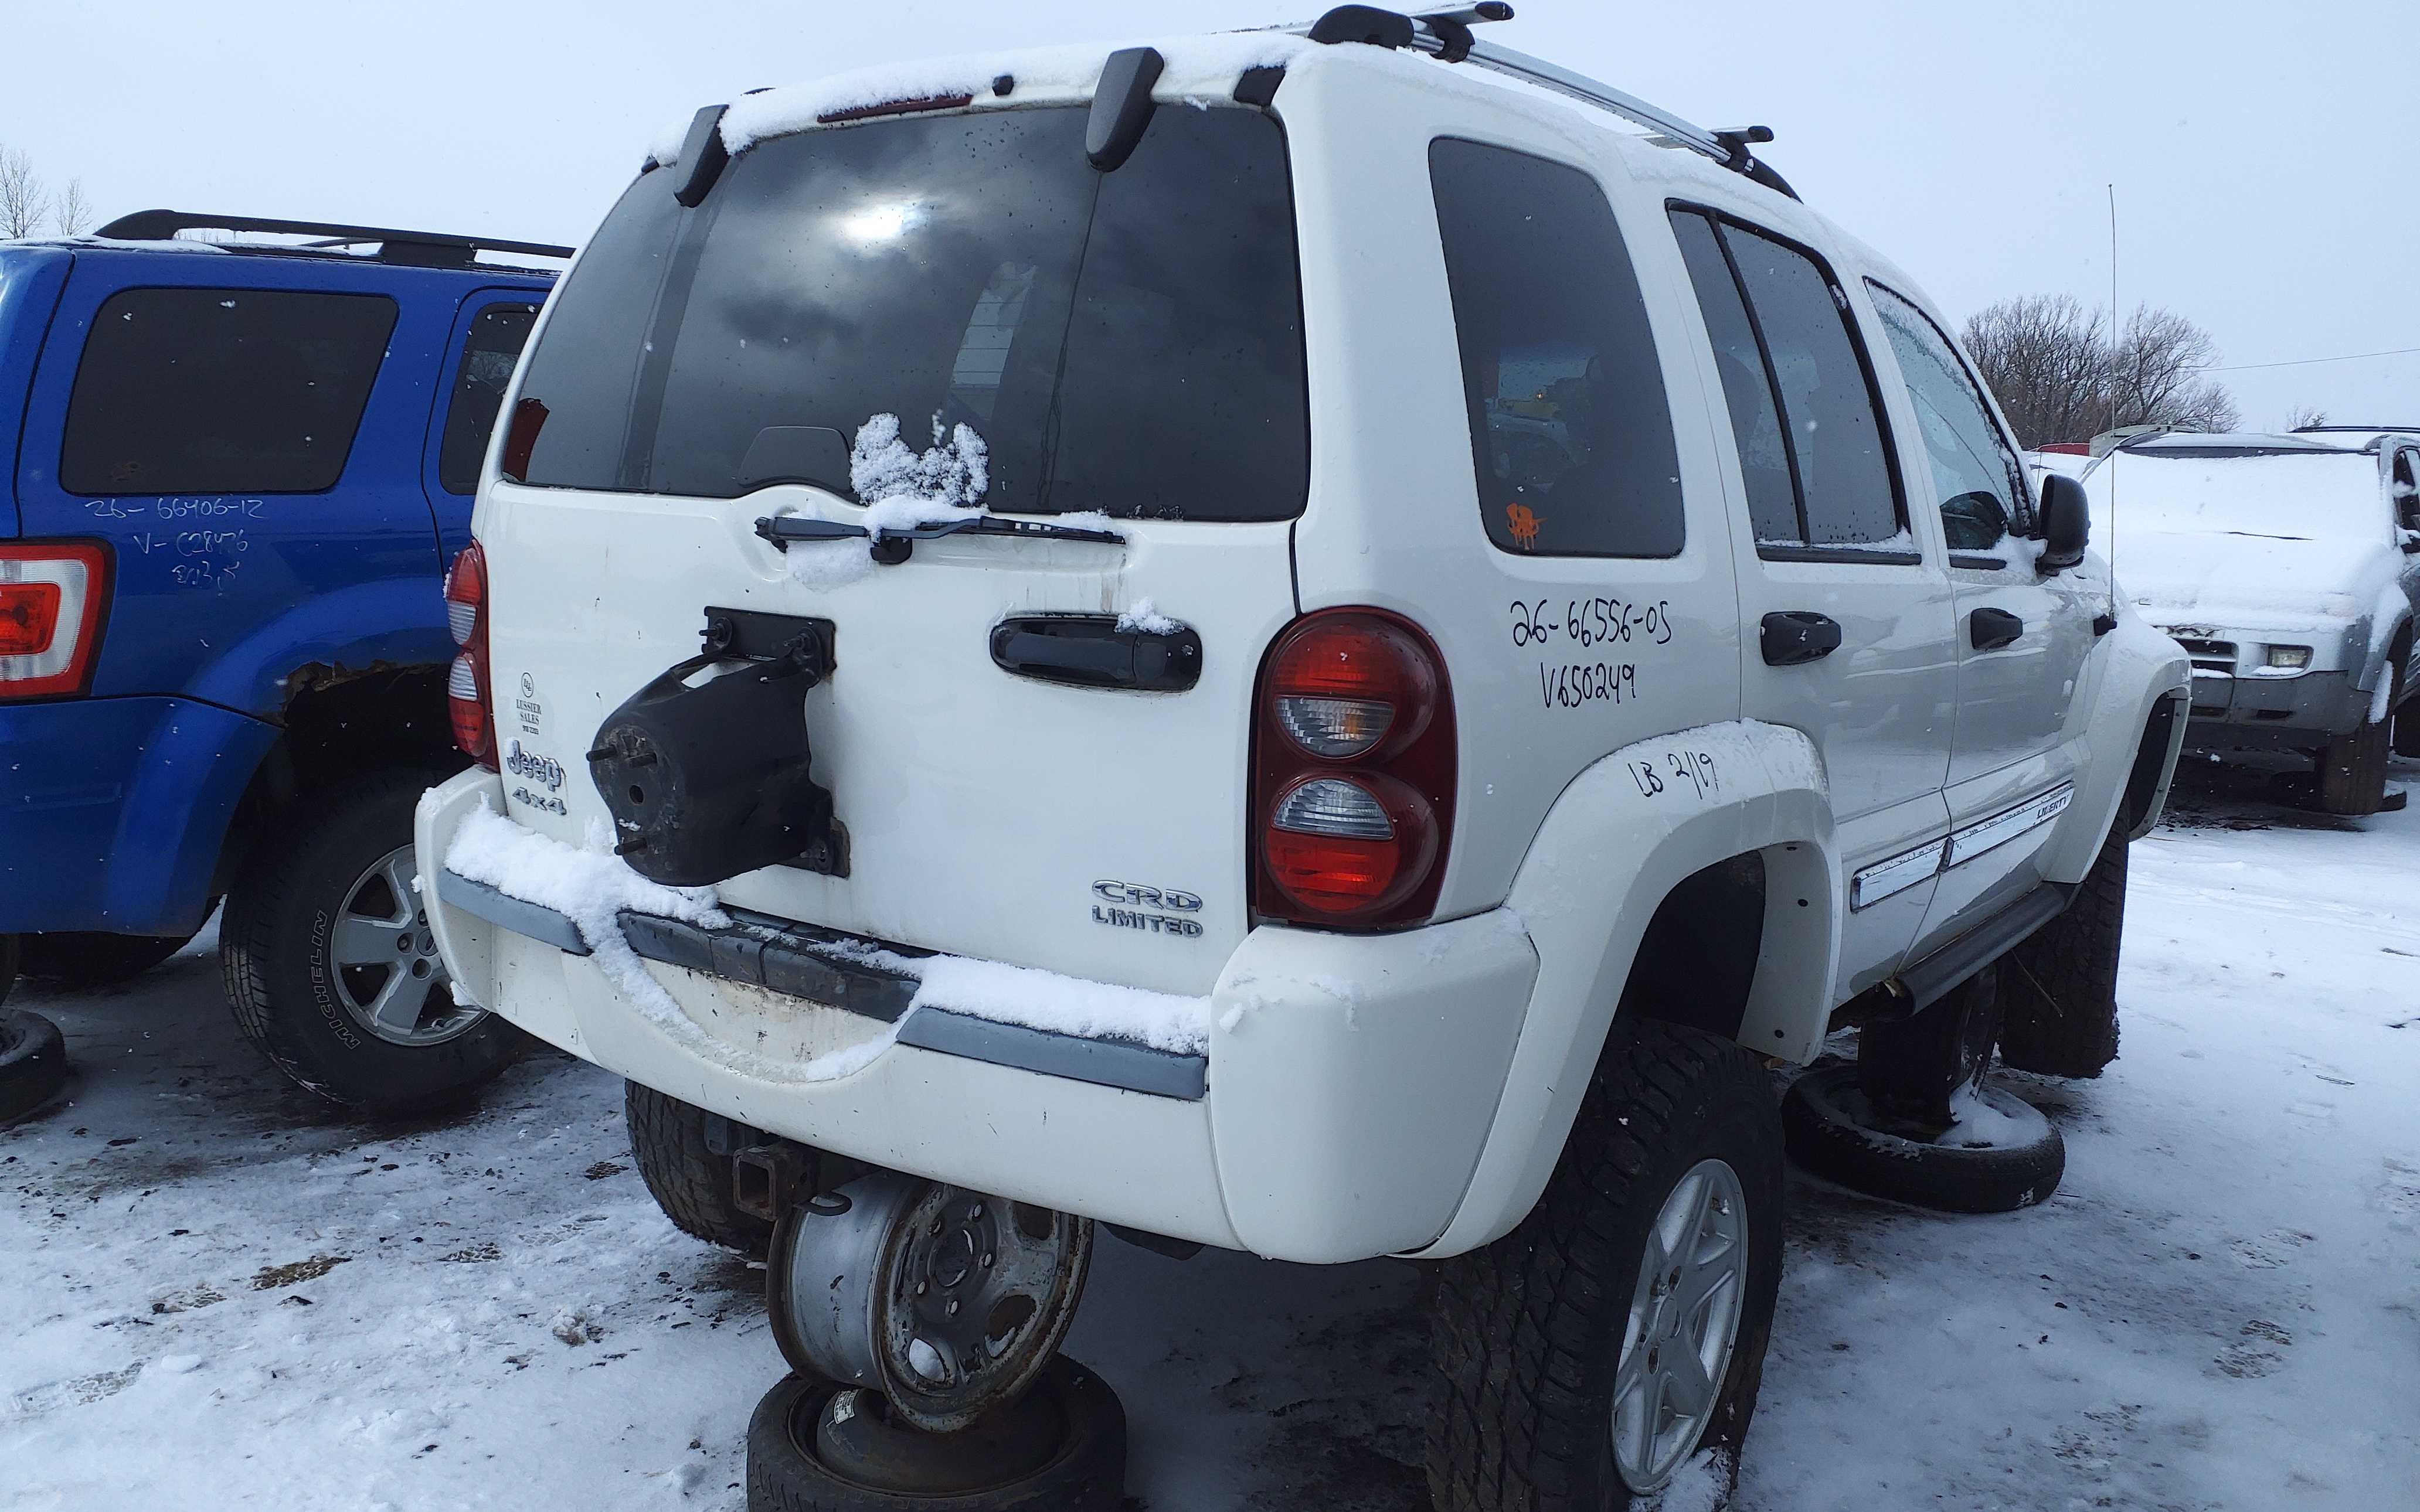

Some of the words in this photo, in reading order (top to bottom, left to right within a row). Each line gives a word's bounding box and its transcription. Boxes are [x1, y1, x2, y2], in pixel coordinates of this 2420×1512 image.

[1540, 662, 1637, 709] V650249
[516, 699, 542, 714] LUSSIER
[519, 711, 539, 726] SALES
[507, 739, 562, 792] Jeep
[1627, 761, 1664, 798] LB
[2037, 794, 2069, 819] LIBERTY
[1091, 879, 1204, 912] CRD
[1091, 905, 1204, 938] LIMITED
[308, 909, 361, 1050] MICHELIN
